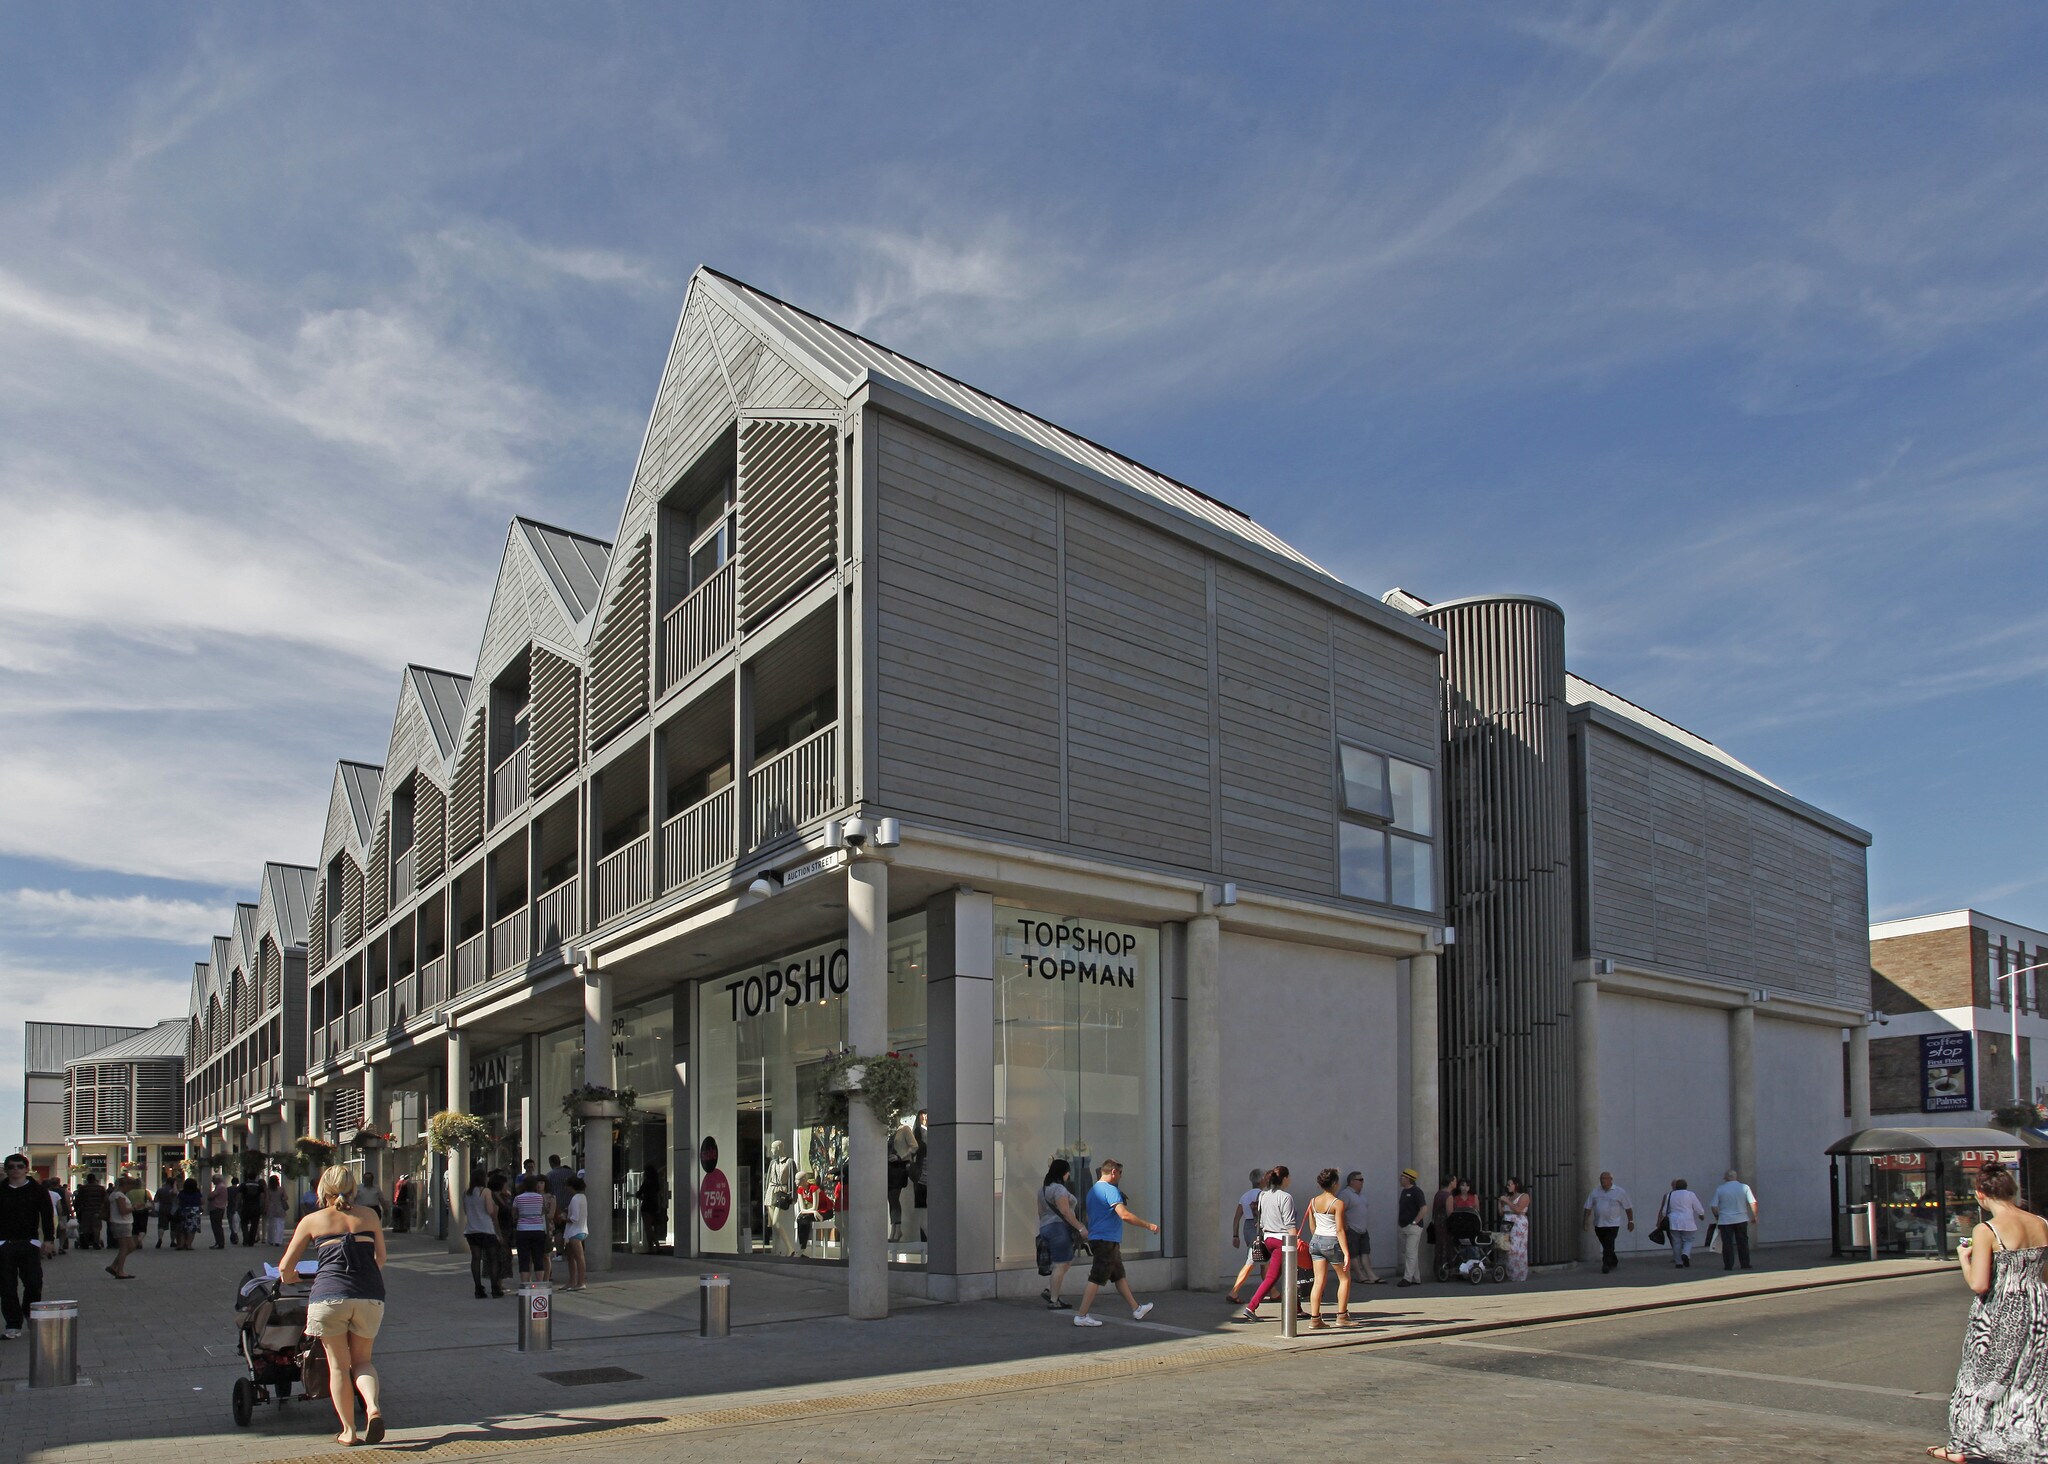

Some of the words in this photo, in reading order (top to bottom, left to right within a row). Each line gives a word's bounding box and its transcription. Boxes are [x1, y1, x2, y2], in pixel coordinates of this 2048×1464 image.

[787, 866, 811, 881] AUCTION
[811, 856, 833, 871] STREET
[1017, 918, 1136, 957] TOPSHOP
[1020, 954, 1134, 988] TOPMAN
[725, 948, 849, 1022] TOPSHO
[1926, 1037, 1964, 1047] coffee
[1928, 1045, 1962, 1058] stop
[469, 1055, 507, 1089] PMAN
[1936, 1096, 1968, 1105] Palmers
[704, 1191, 726, 1207] 75%
[704, 1209, 713, 1219] off
